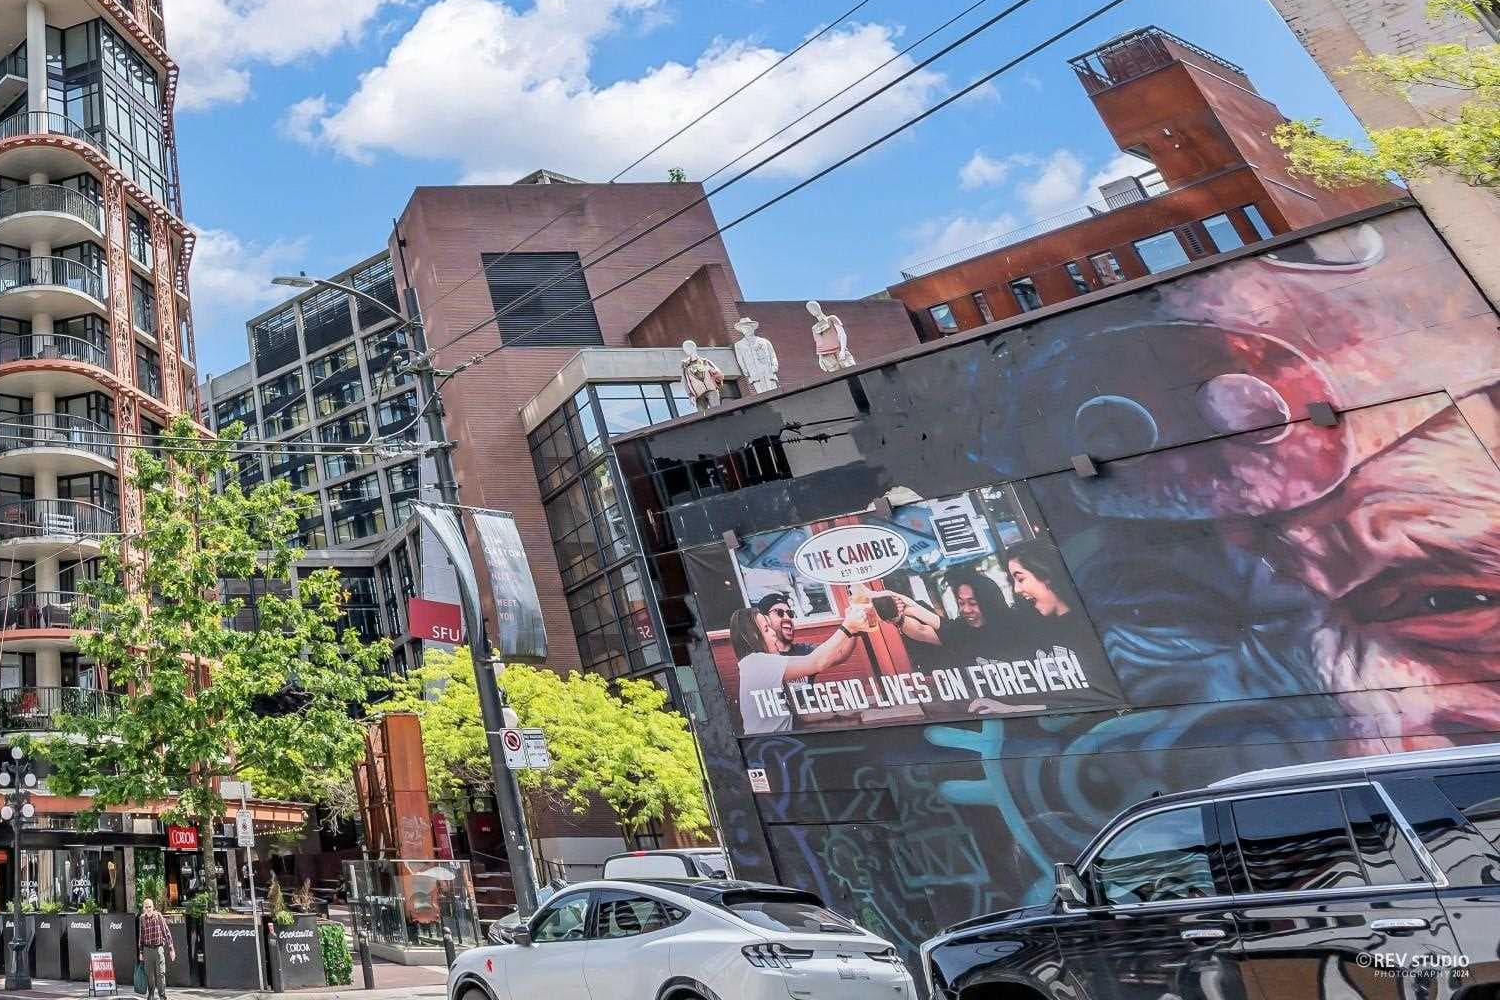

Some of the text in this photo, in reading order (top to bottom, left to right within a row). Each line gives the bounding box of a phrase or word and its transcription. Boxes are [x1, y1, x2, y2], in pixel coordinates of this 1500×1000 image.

[803, 550, 835, 571] THE
[837, 538, 898, 565] CAMBIE
[432, 626, 460, 642] SFU
[750, 652, 1090, 719] THE LEGEND LIVES ON FOREVER!
[212, 928, 257, 942] Burgers
